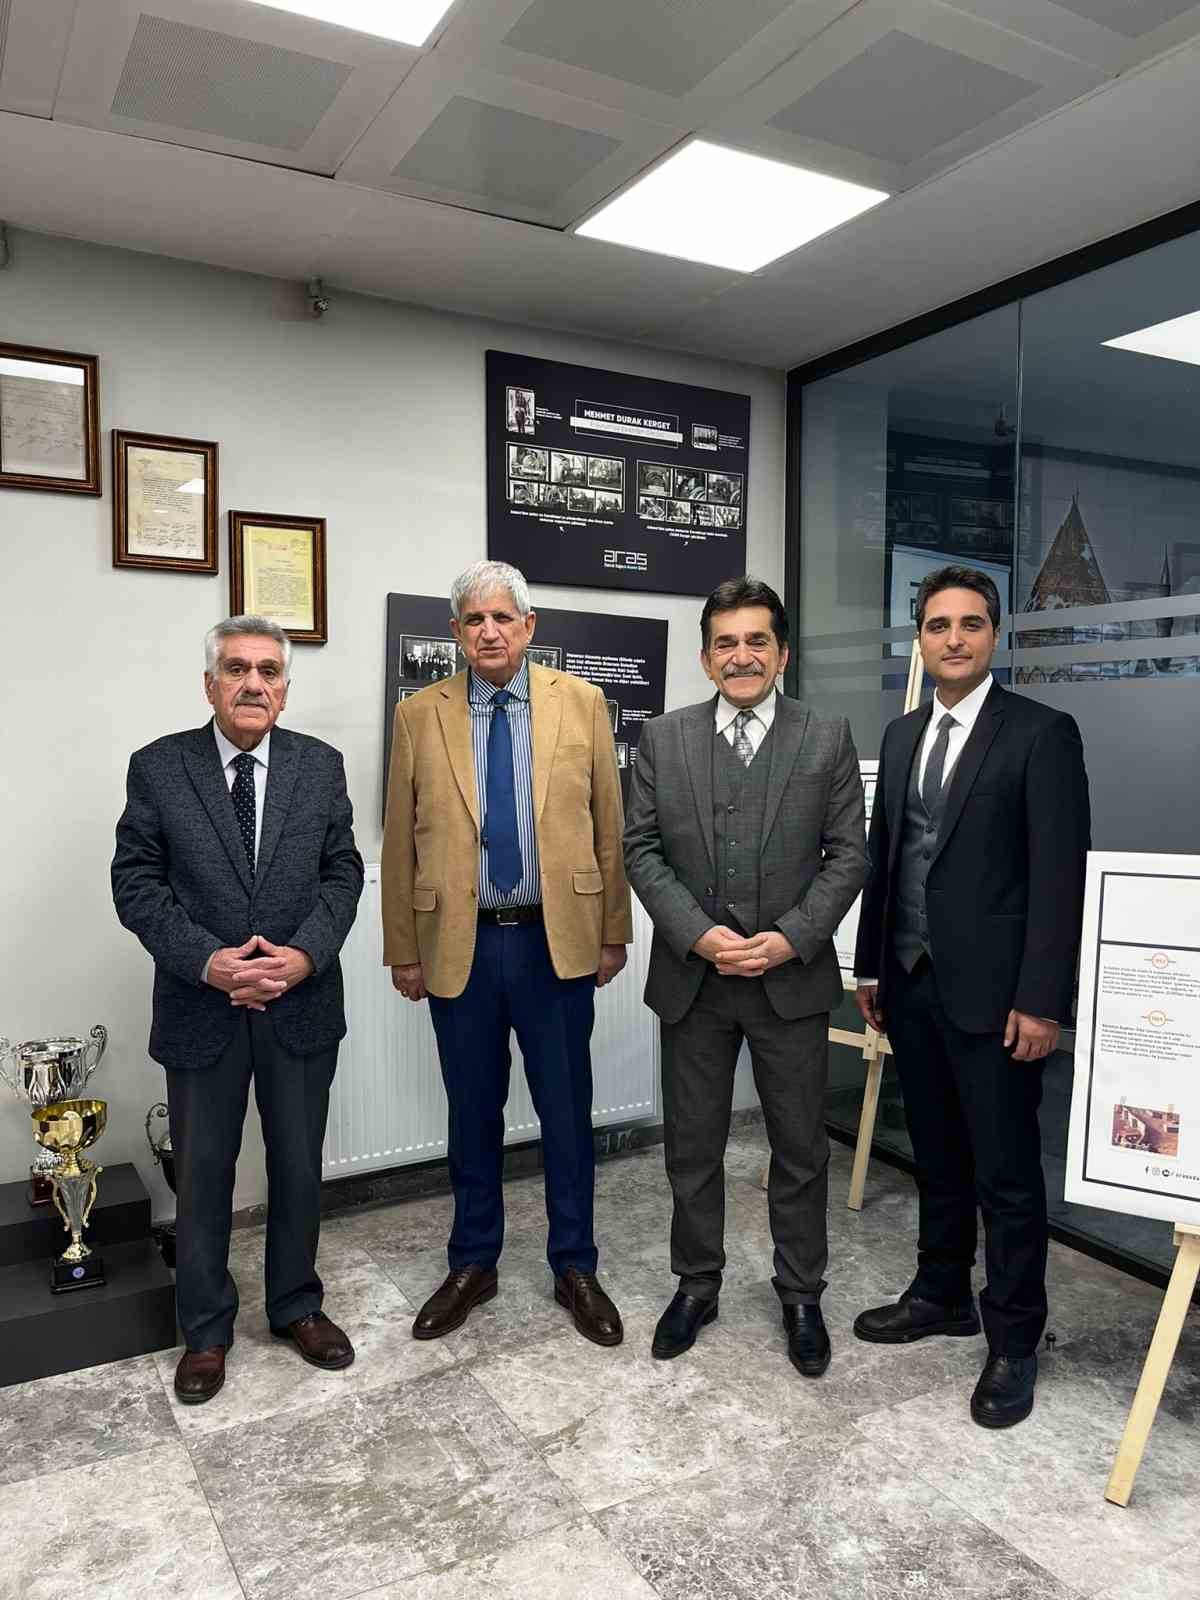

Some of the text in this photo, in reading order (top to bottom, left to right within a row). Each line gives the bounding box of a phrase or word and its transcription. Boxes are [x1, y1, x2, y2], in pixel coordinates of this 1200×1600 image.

[584, 409, 615, 422] MEHMET
[616, 414, 642, 426] DURAK
[604, 549, 648, 566] aras
